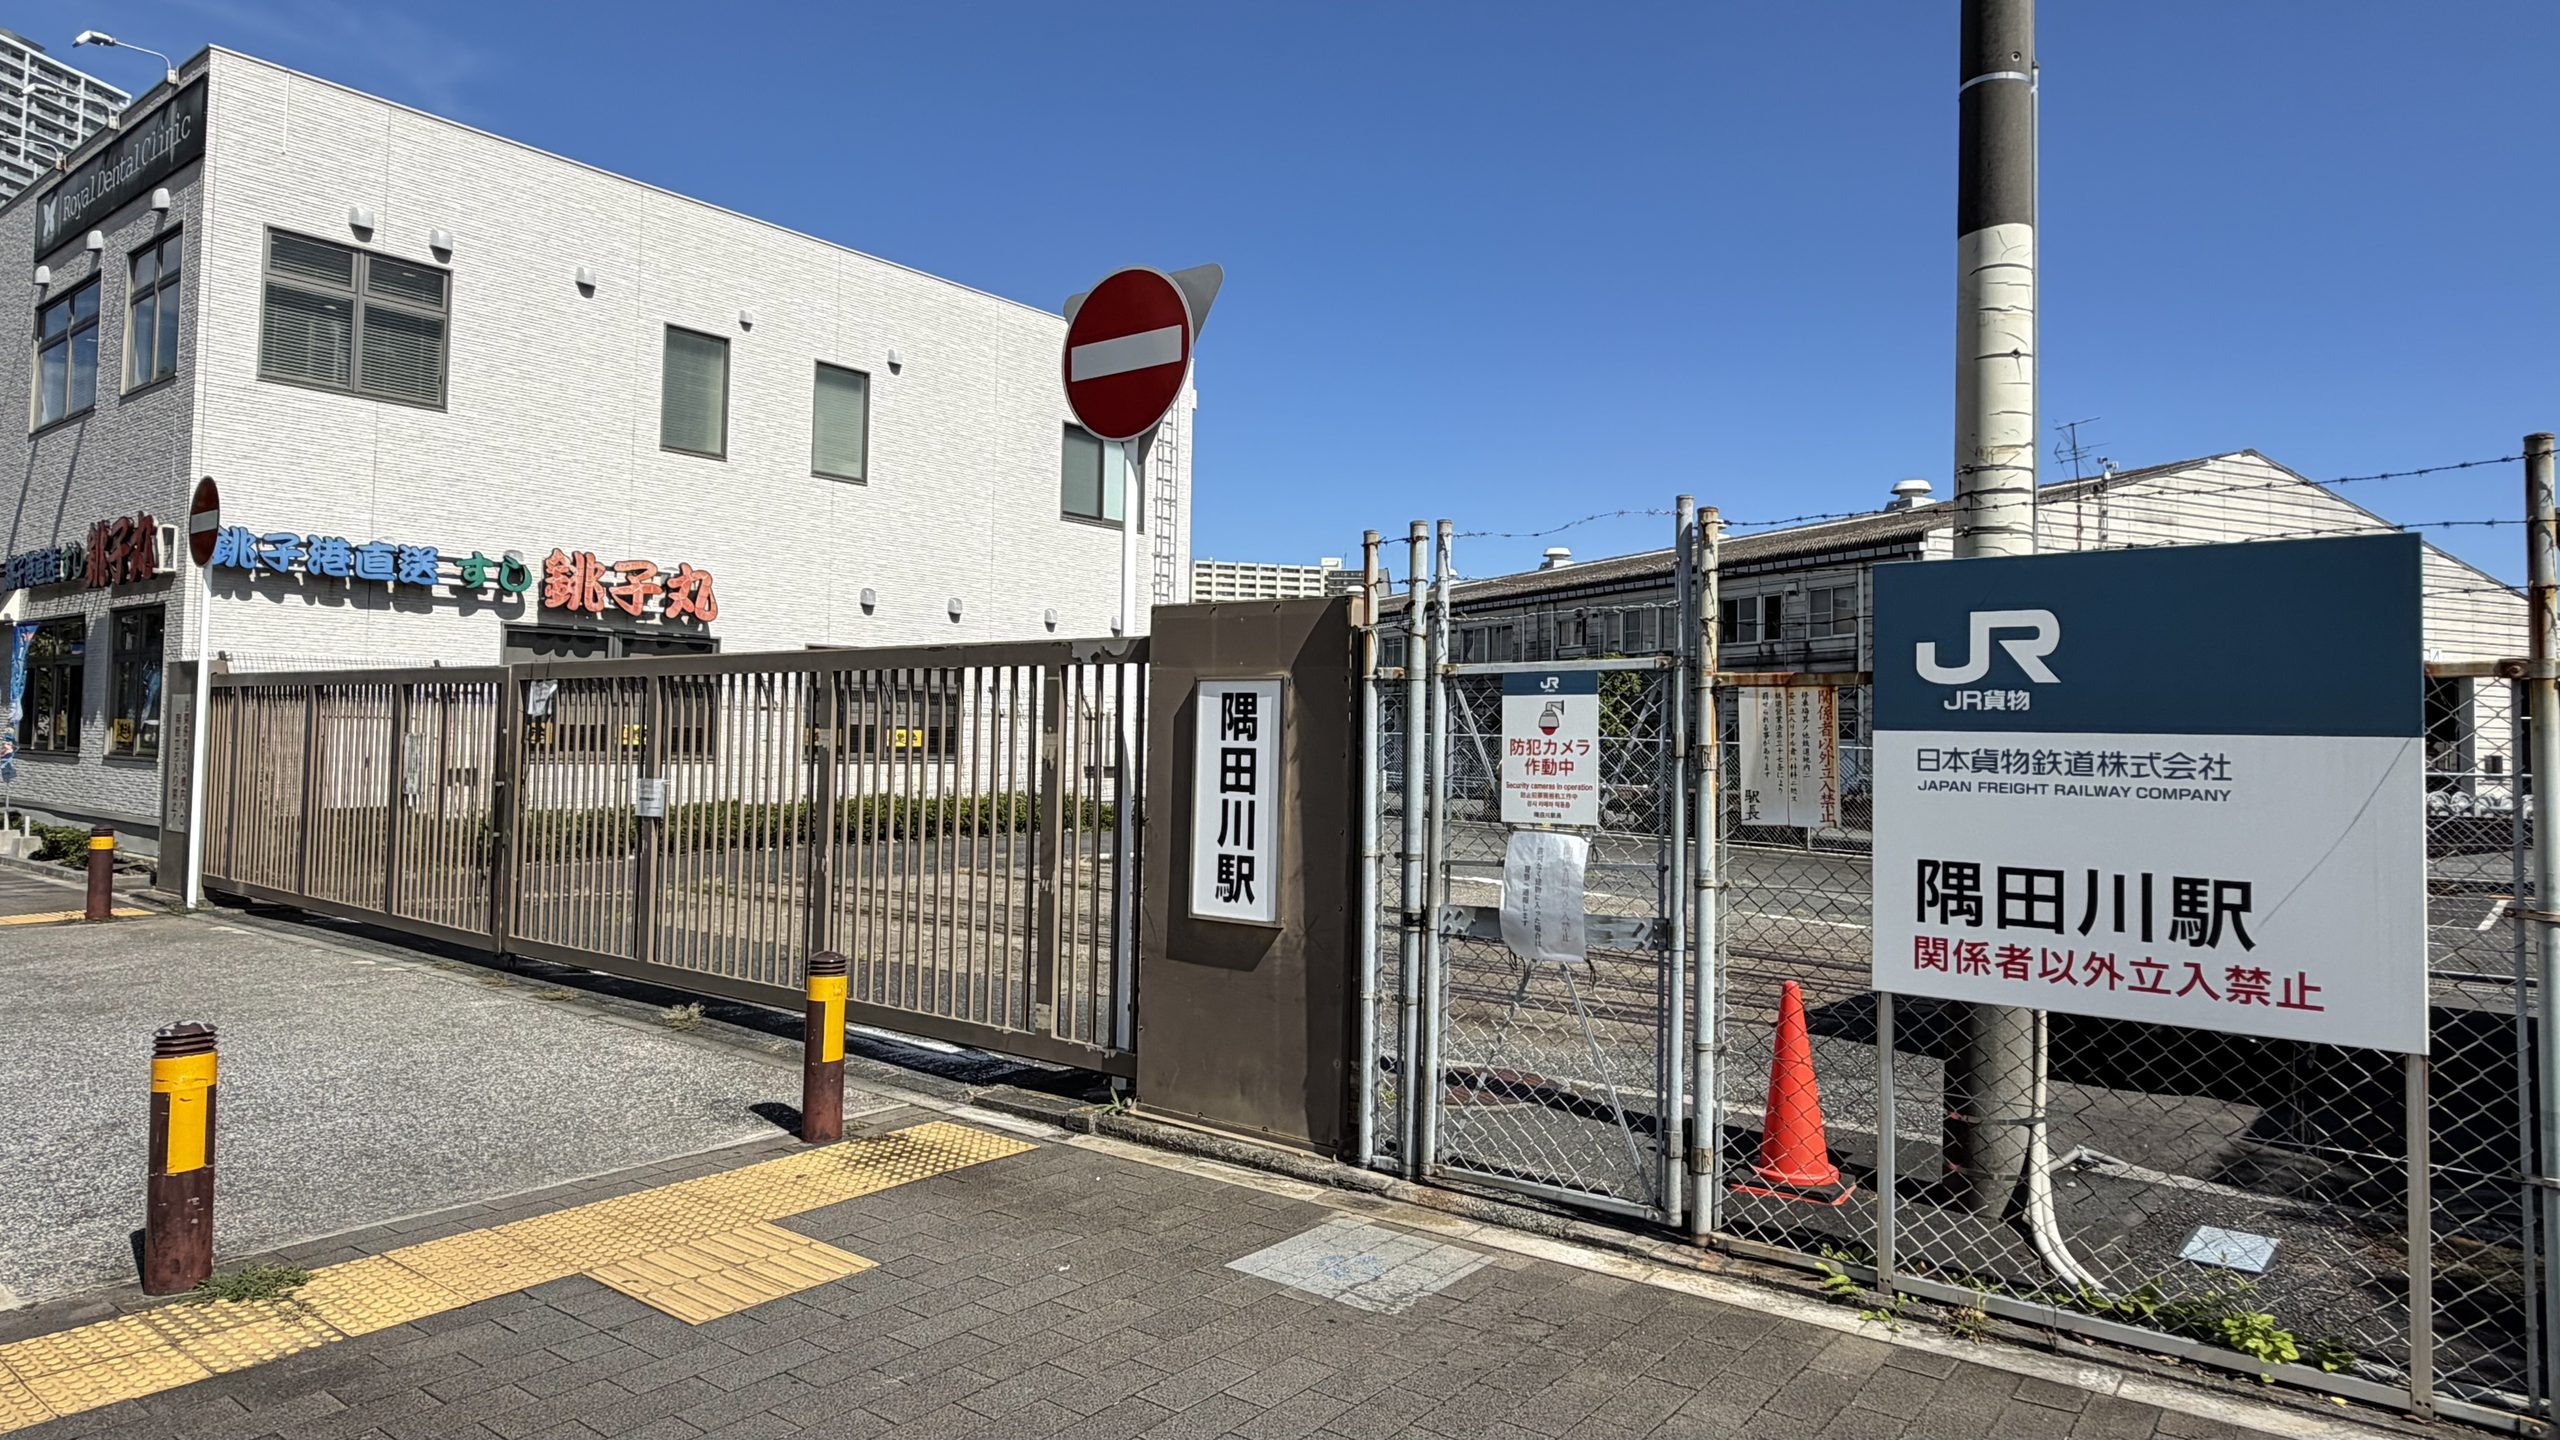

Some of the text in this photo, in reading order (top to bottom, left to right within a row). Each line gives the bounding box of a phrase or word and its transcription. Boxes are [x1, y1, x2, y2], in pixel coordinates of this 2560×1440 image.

[63, 112, 192, 221] Royal Dental Clinic
[62, 541, 84, 581] すし
[86, 511, 155, 588] 銚子丸
[212, 526, 718, 622] 銚子港直送 すし 銚子丸
[1915, 608, 2062, 685] JR
[1540, 677, 1559, 689] JR
[1943, 689, 2030, 712] JR貨物
[1510, 738, 1590, 756] 防犯カメラ
[1525, 758, 1574, 776] 作動中
[1817, 689, 1835, 824] 関係者以外立入禁止
[1916, 747, 2233, 783] 日本貨物鉄道株式会社
[1215, 692, 1258, 905] 隅田川駅
[1506, 782, 1529, 790] Security
[1564, 784, 1593, 792] operation
[1744, 789, 1761, 821] 駅長
[1916, 779, 2232, 803] JAPAN FREIGHT RAILWAY COMPANY
[1915, 858, 2257, 952] 隅田川駅
[1913, 935, 2326, 1013] 関係者以外立入禁止
